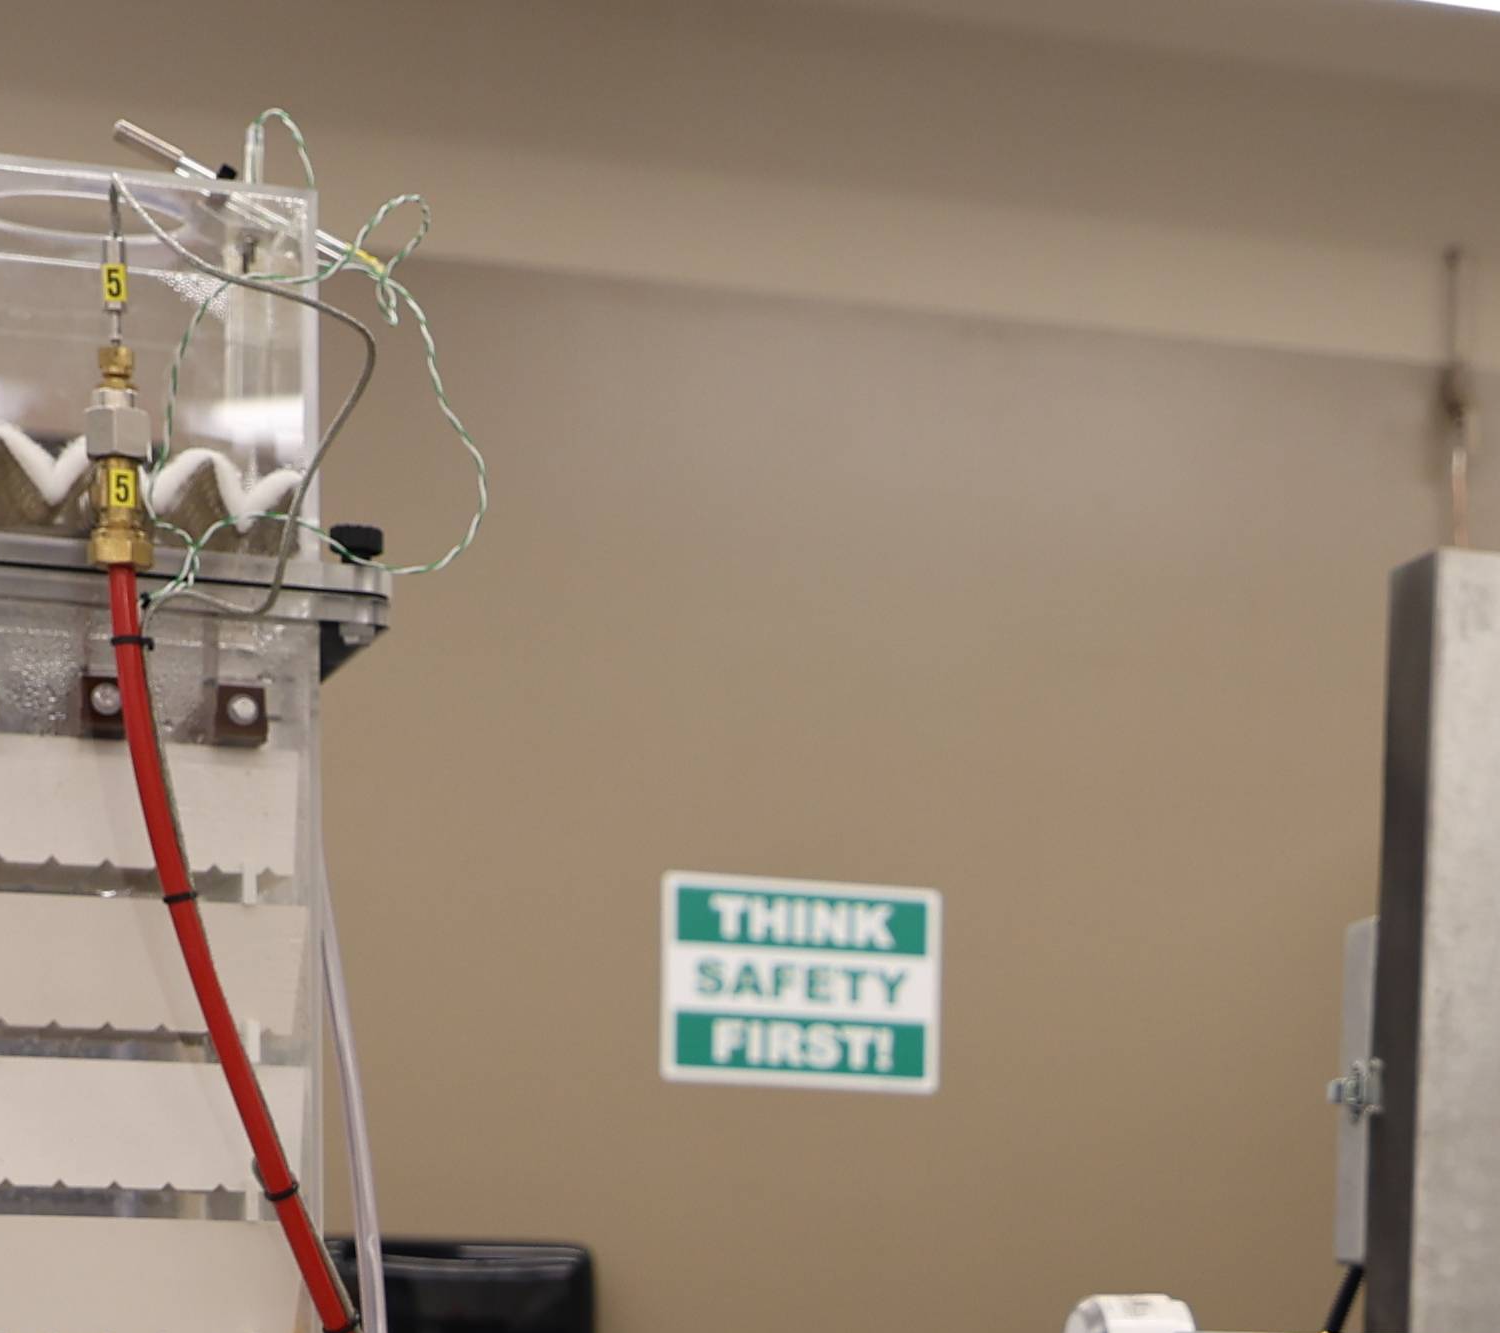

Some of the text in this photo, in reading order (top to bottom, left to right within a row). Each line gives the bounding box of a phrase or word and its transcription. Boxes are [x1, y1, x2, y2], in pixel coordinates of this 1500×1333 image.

[106, 268, 122, 298] 5
[114, 474, 130, 503] 5
[708, 892, 896, 950] THINK
[695, 956, 910, 1007] SAFETY
[711, 1016, 895, 1072] FIRST!
